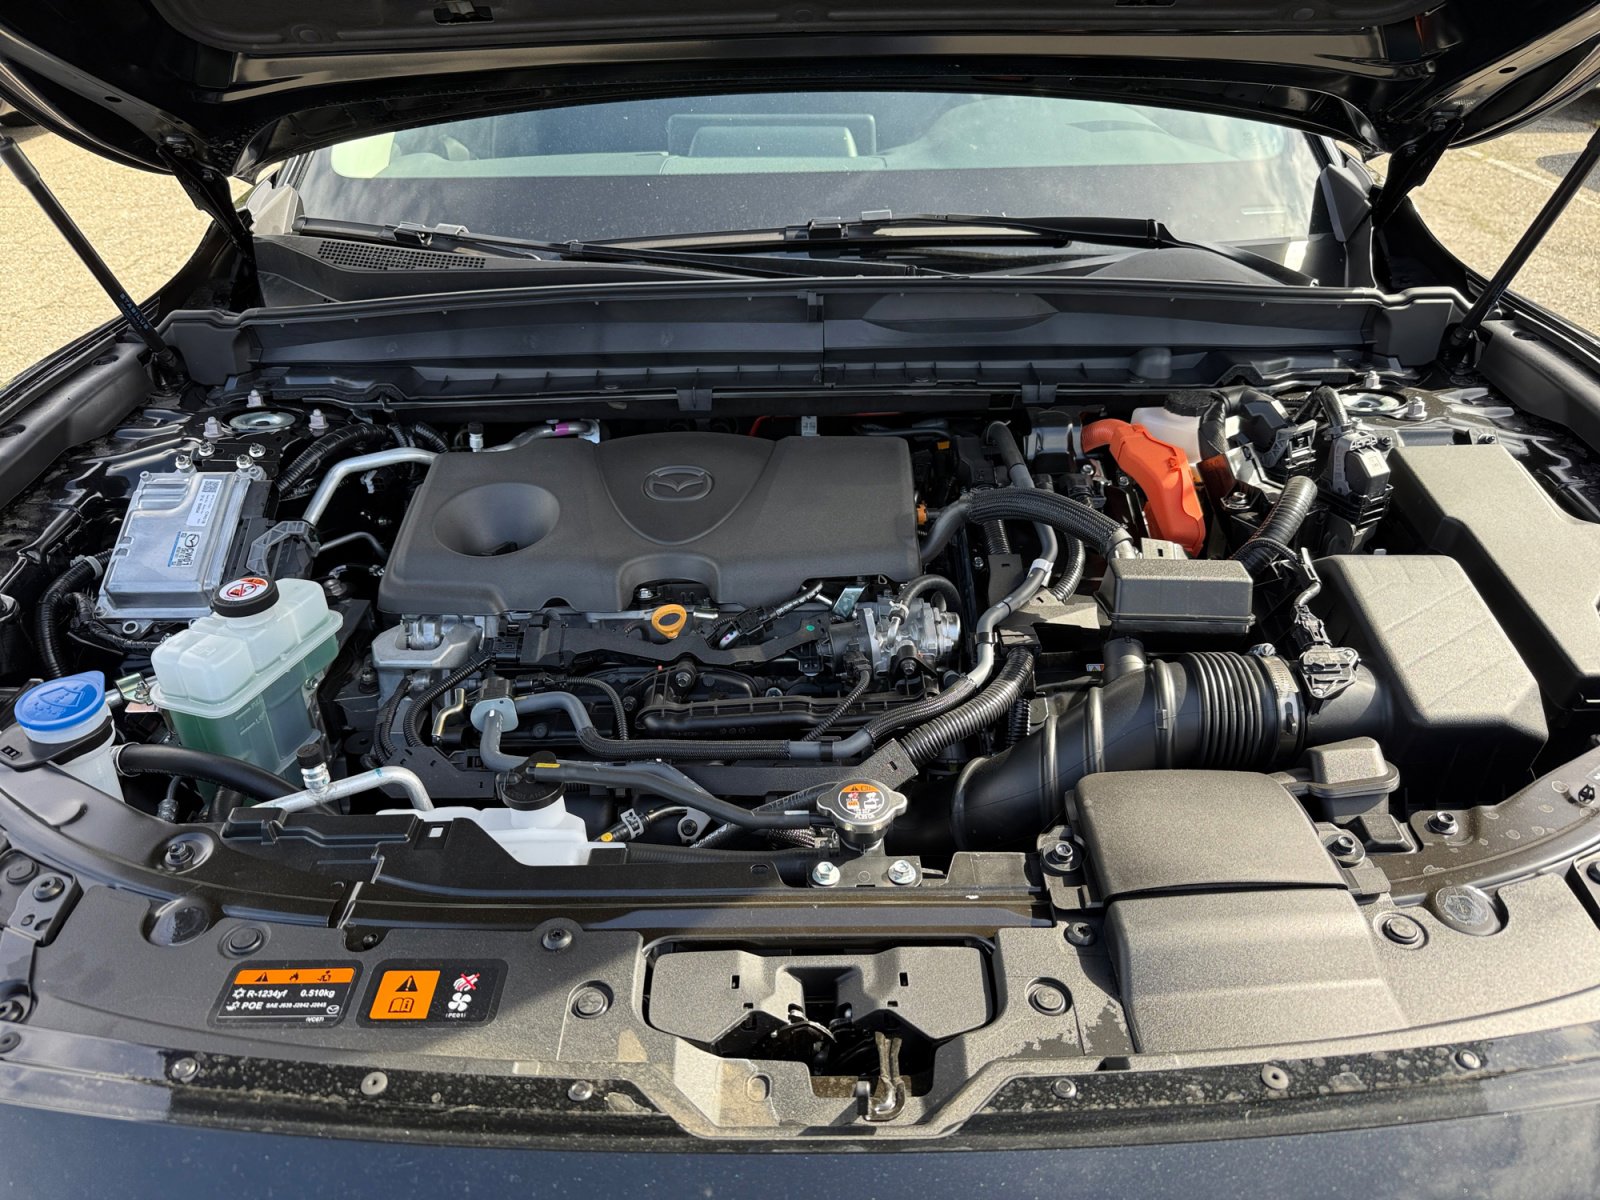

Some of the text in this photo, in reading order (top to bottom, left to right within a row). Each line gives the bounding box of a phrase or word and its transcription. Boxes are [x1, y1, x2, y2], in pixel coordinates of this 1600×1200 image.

[246, 988, 336, 999] R-1234yf 0.510kg
[241, 1001, 264, 1011] POE
